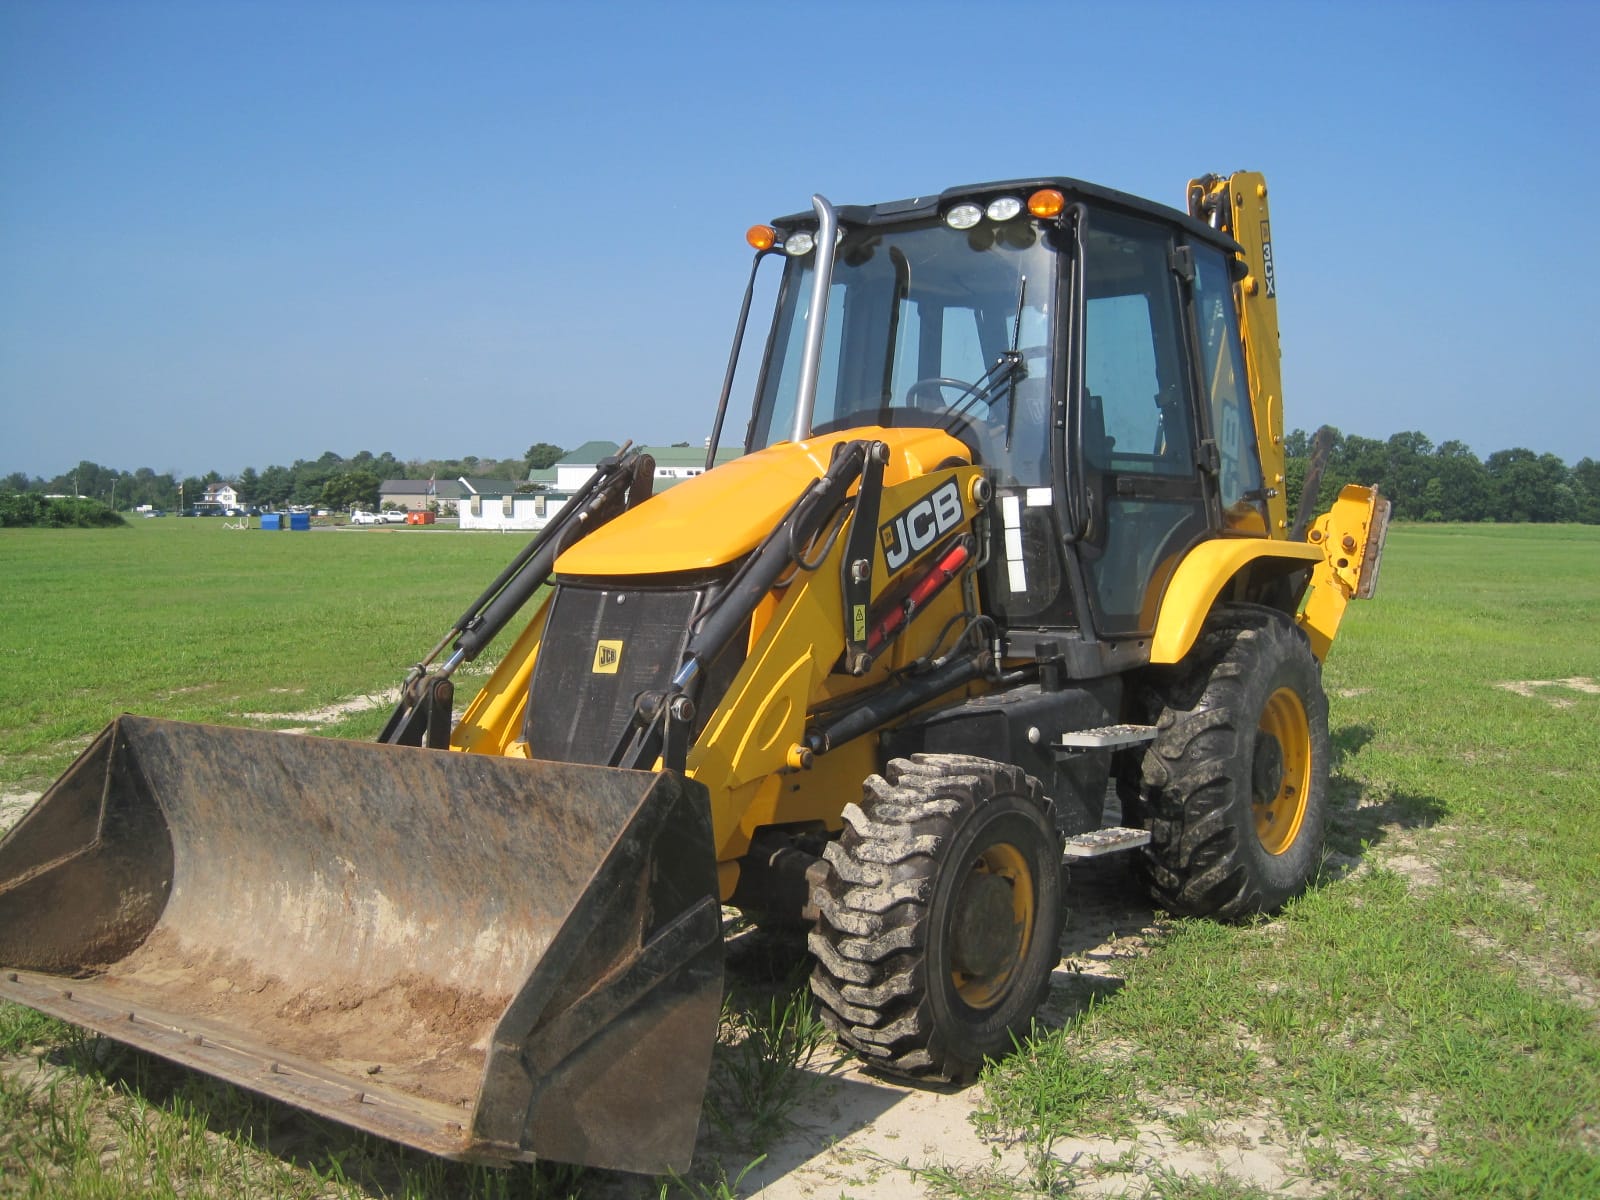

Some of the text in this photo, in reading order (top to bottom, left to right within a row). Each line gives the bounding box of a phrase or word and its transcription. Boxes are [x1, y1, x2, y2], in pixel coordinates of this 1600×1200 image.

[1263, 244, 1275, 294] 3CX
[886, 482, 962, 569] JCB
[600, 648, 617, 665] JCB
